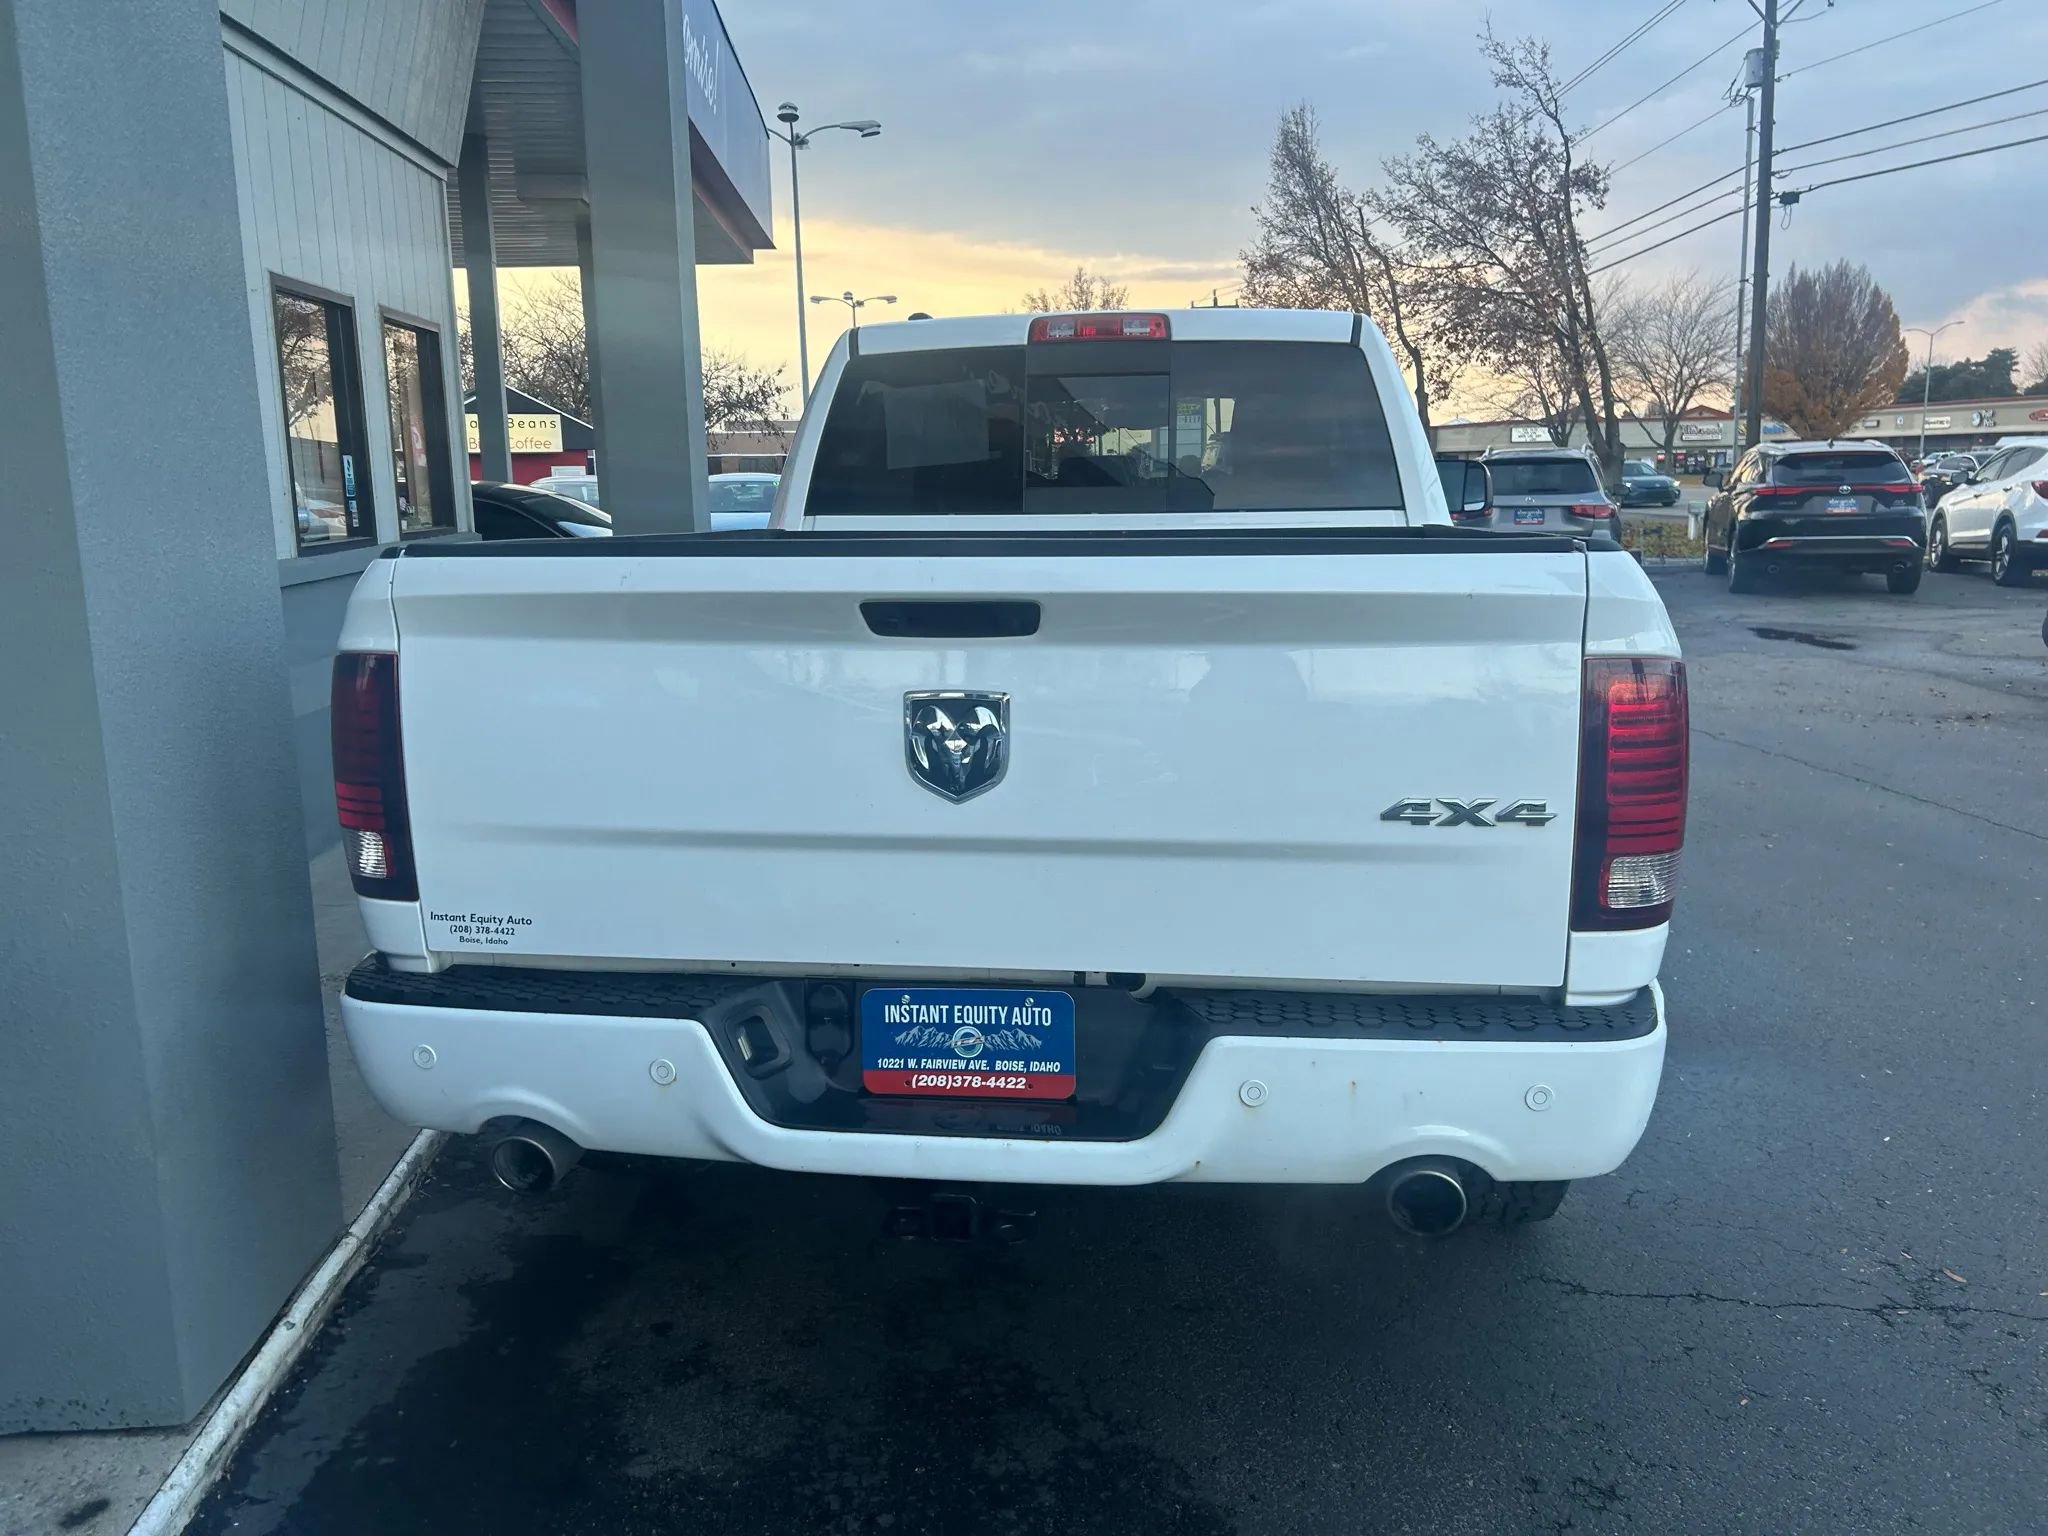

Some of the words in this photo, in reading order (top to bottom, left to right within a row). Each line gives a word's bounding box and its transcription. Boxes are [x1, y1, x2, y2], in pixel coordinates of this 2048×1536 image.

[507, 417, 557, 429] Beans
[508, 437, 552, 450] Coffee
[430, 911, 466, 922] Instant
[470, 913, 504, 926] Equity
[506, 915, 533, 926] Auto
[449, 925, 472, 934] (208)
[475, 926, 515, 936] 378-4422
[459, 936, 483, 945] Boise,
[485, 937, 508, 946] Idaho
[884, 1004, 950, 1024] INSTANT
[953, 1005, 1008, 1025] EQUITY
[1011, 1007, 1052, 1027] AUTO
[877, 1058, 905, 1070] 10221
[907, 1059, 918, 1070] W.
[920, 1059, 968, 1071] FAIRVIEW
[968, 1060, 990, 1071] AVE.
[995, 1061, 1027, 1073] BOISE,
[1029, 1062, 1061, 1073] IDAHO
[911, 1074, 1027, 1090] (208)378-4422
